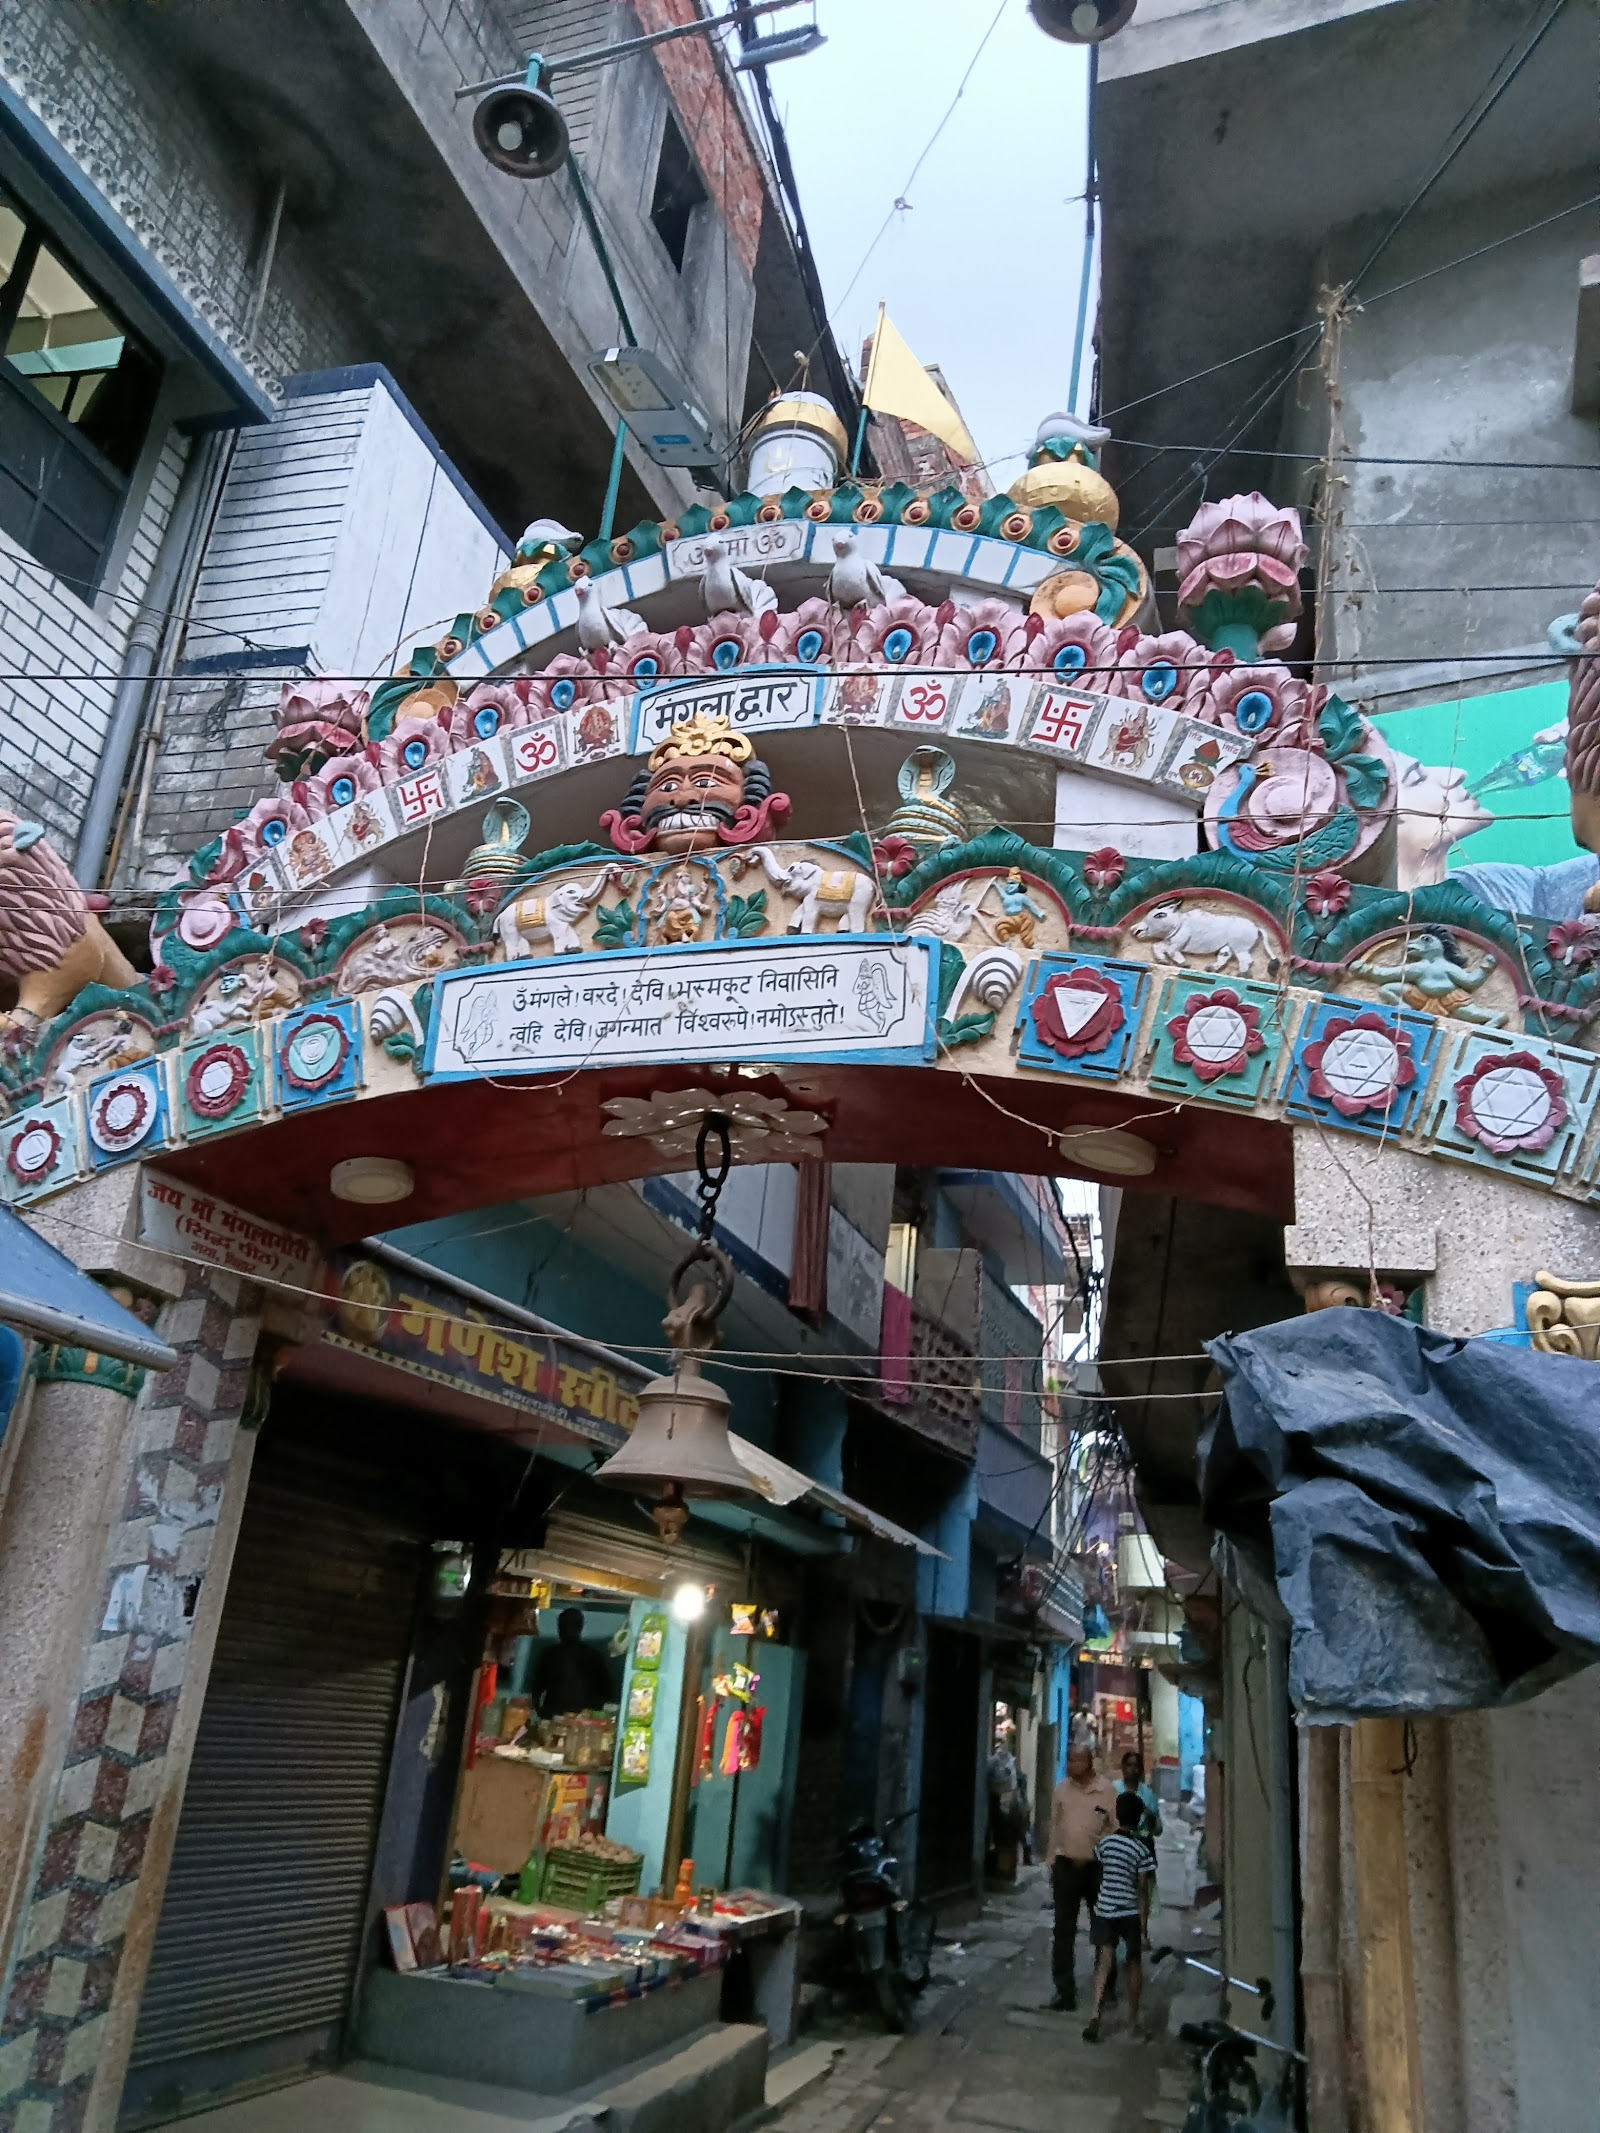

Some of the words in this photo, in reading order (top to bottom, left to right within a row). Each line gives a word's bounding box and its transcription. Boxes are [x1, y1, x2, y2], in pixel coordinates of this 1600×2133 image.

[734, 681, 798, 722] द्वार
[757, 963, 841, 994] निवासिनि
[147, 1178, 187, 1211] जय
[398, 1292, 545, 1394] गणेश
